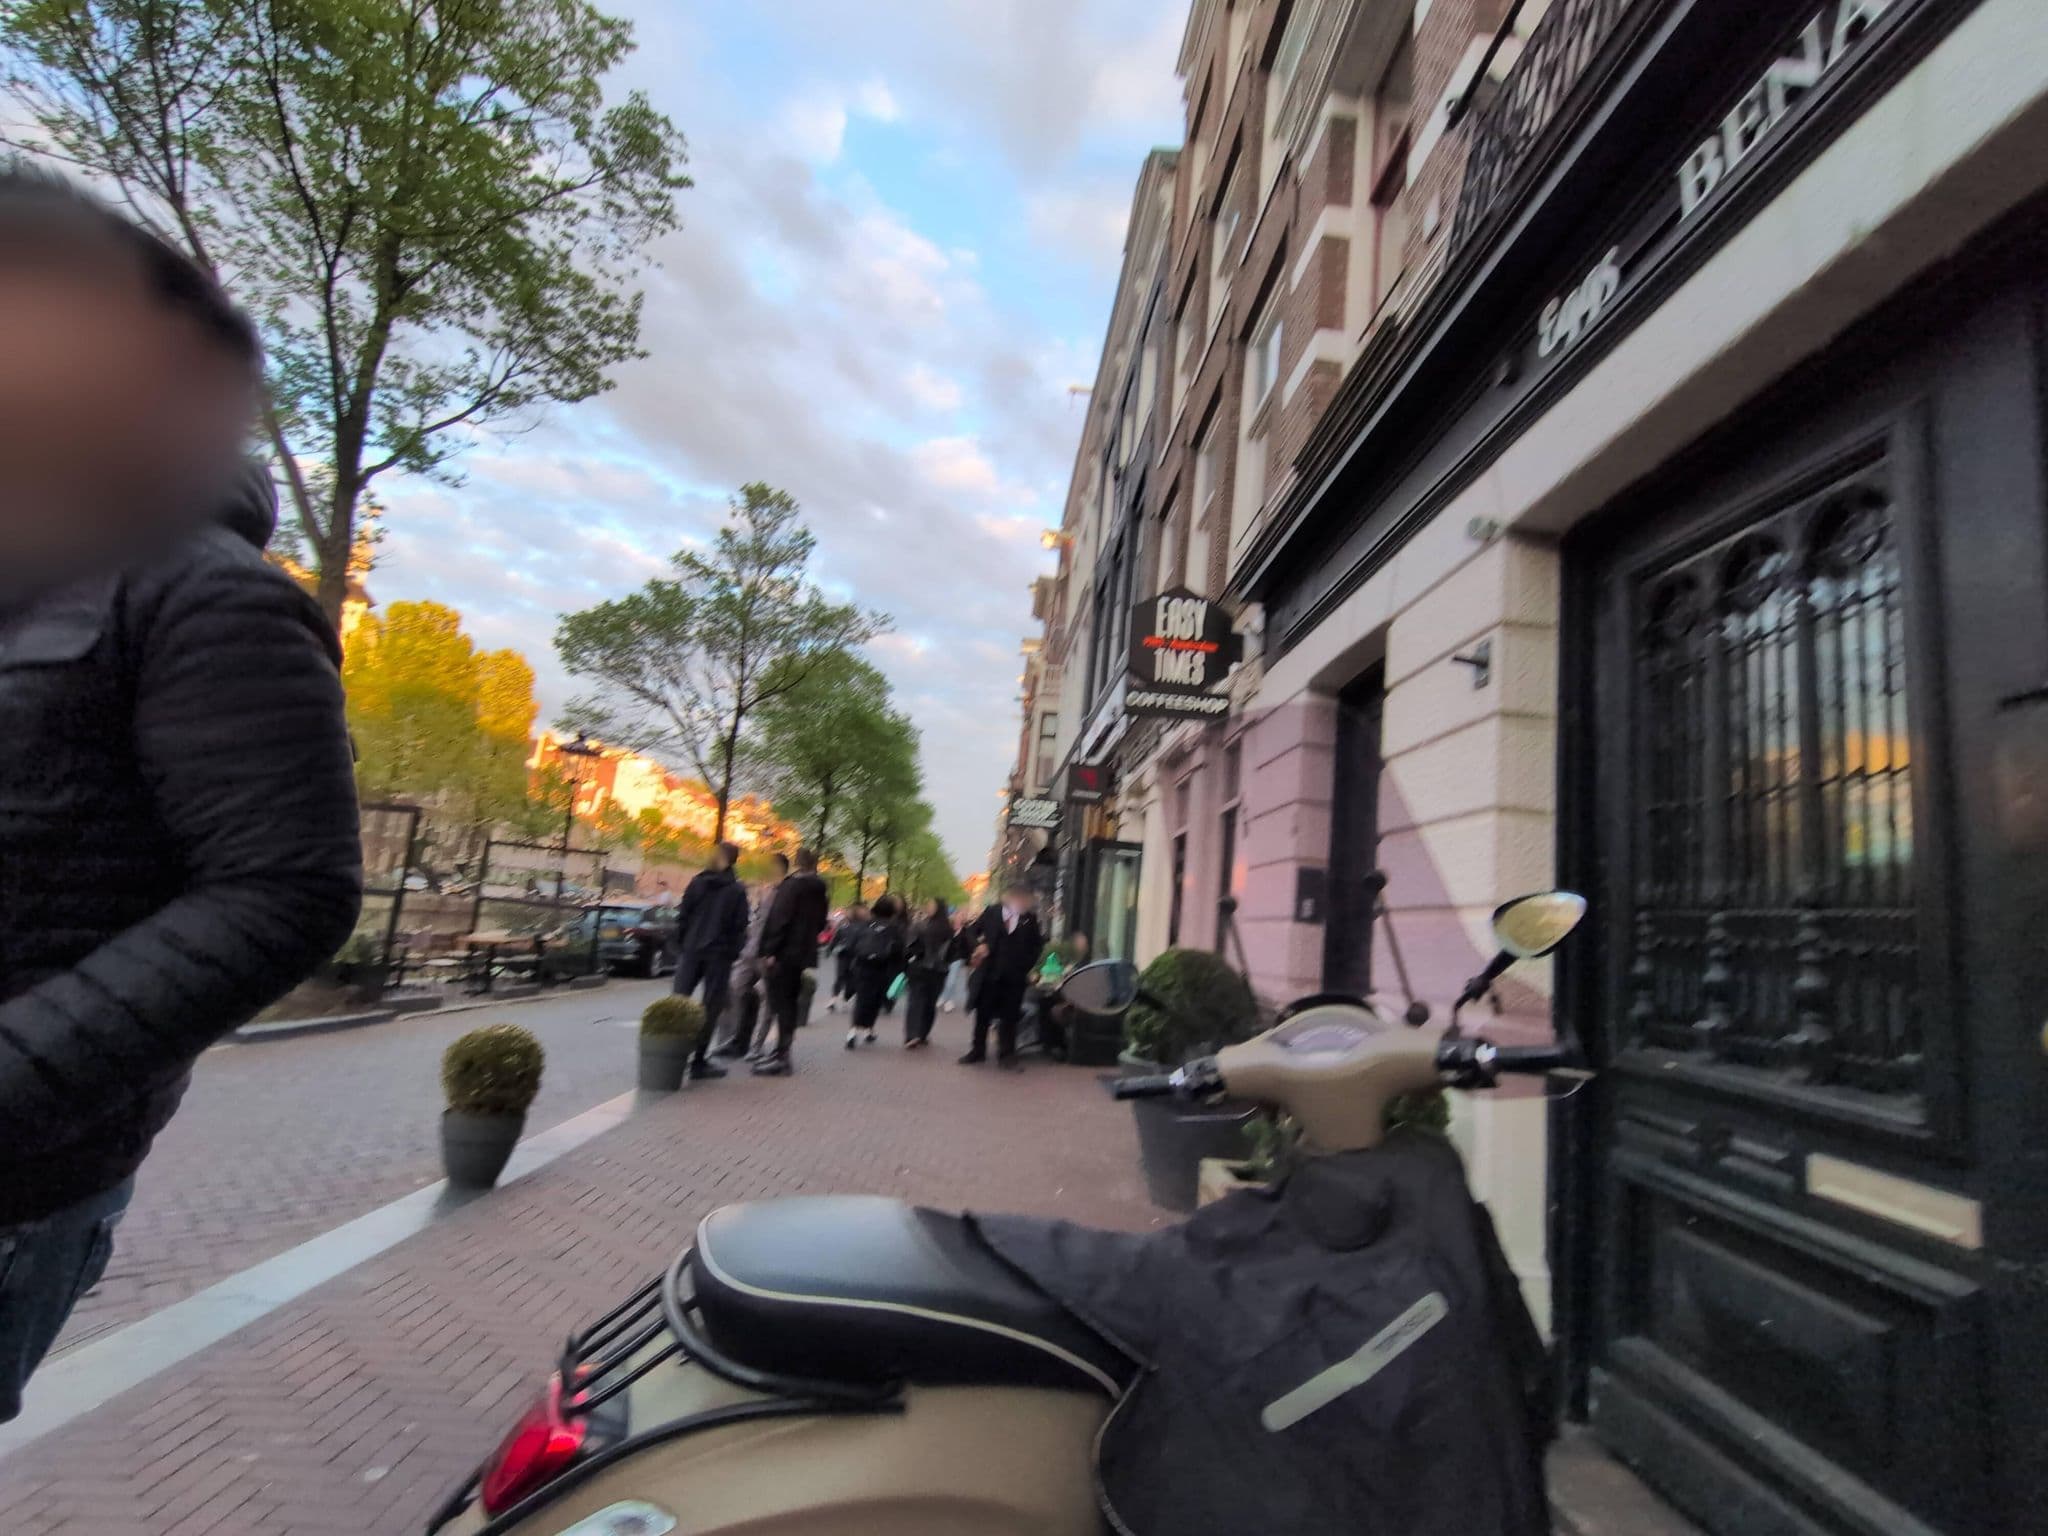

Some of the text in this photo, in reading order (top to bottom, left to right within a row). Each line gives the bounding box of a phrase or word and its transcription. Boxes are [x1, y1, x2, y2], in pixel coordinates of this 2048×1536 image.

[1155, 596, 1208, 641] EASY
[1153, 647, 1206, 686] TIMES
[1126, 690, 1229, 714] COFFEESHOP
